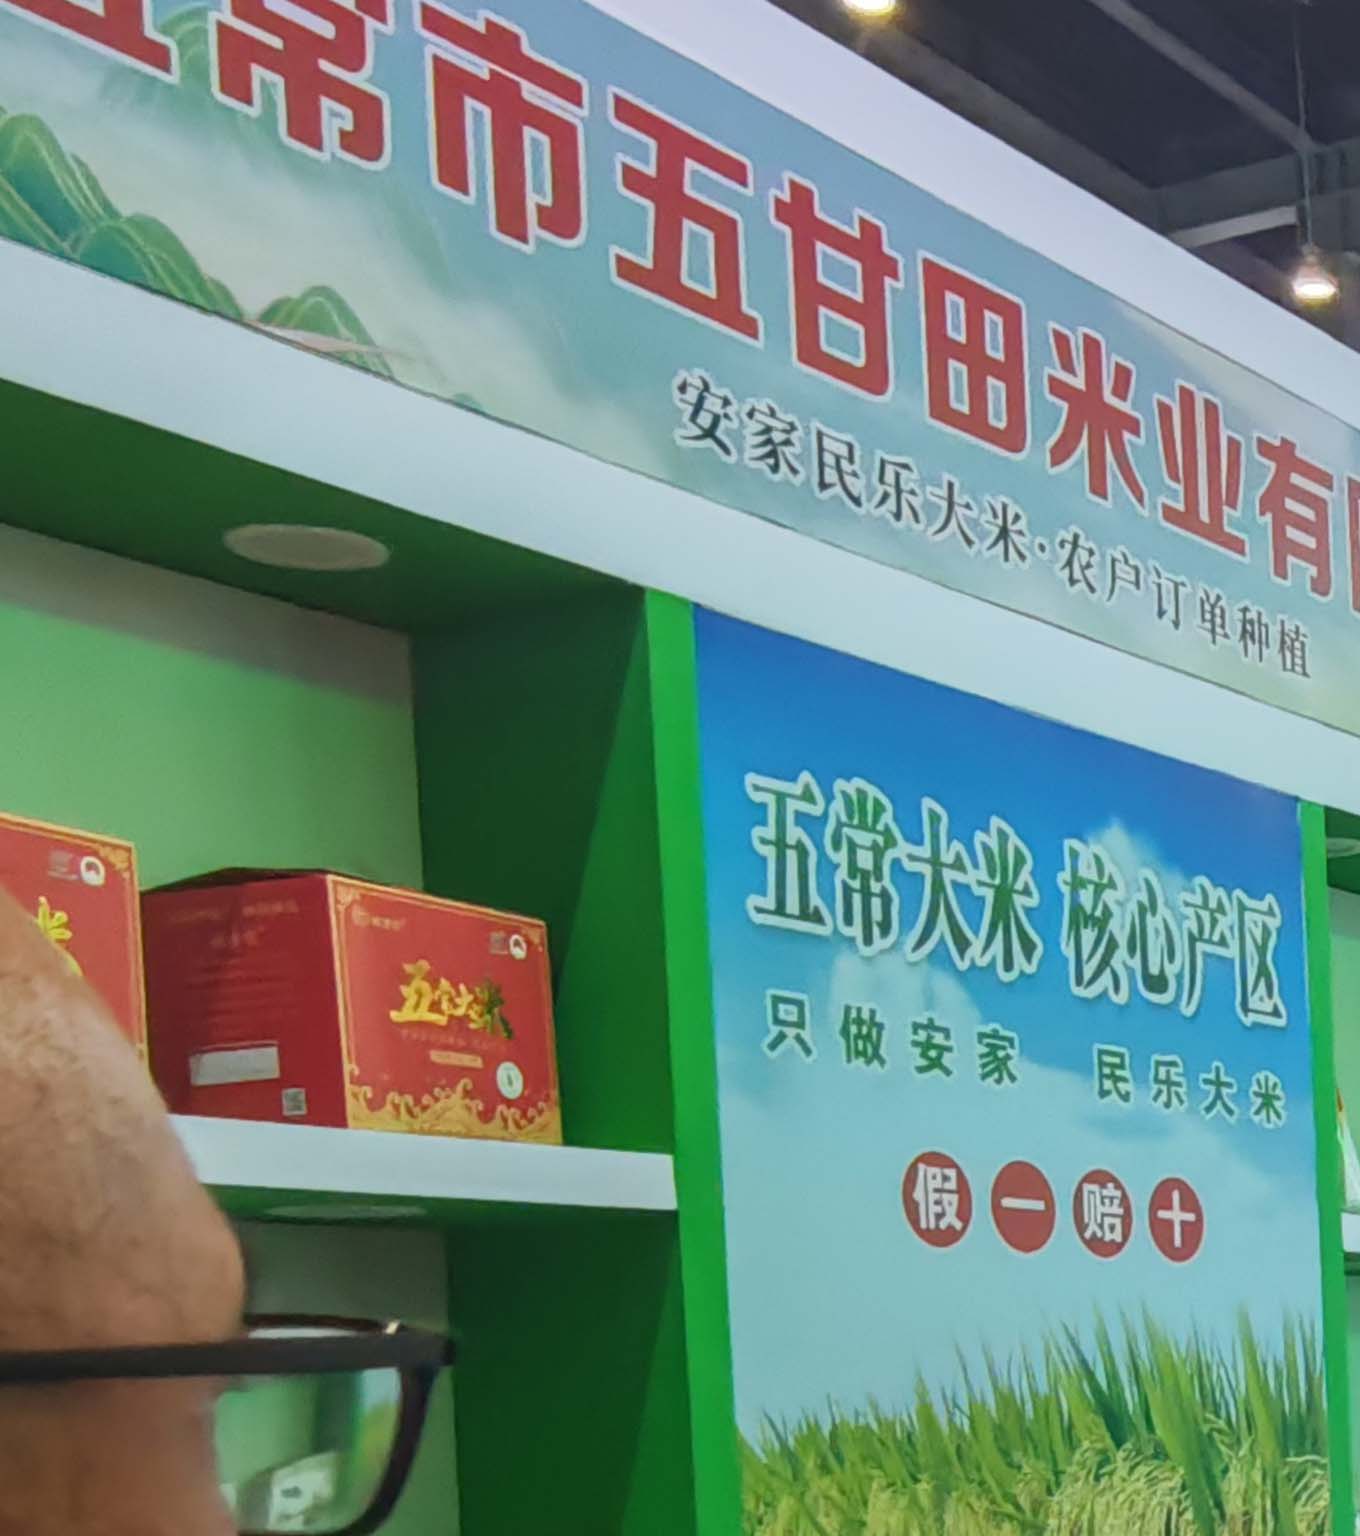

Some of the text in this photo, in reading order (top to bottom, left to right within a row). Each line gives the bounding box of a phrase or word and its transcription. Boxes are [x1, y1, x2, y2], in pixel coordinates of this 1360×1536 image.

[745, 770, 1288, 1027] 五常大米 核心产区
[763, 990, 1288, 1128] 只做安家 民乐大米
[911, 1160, 1197, 1248] 假一赔十
